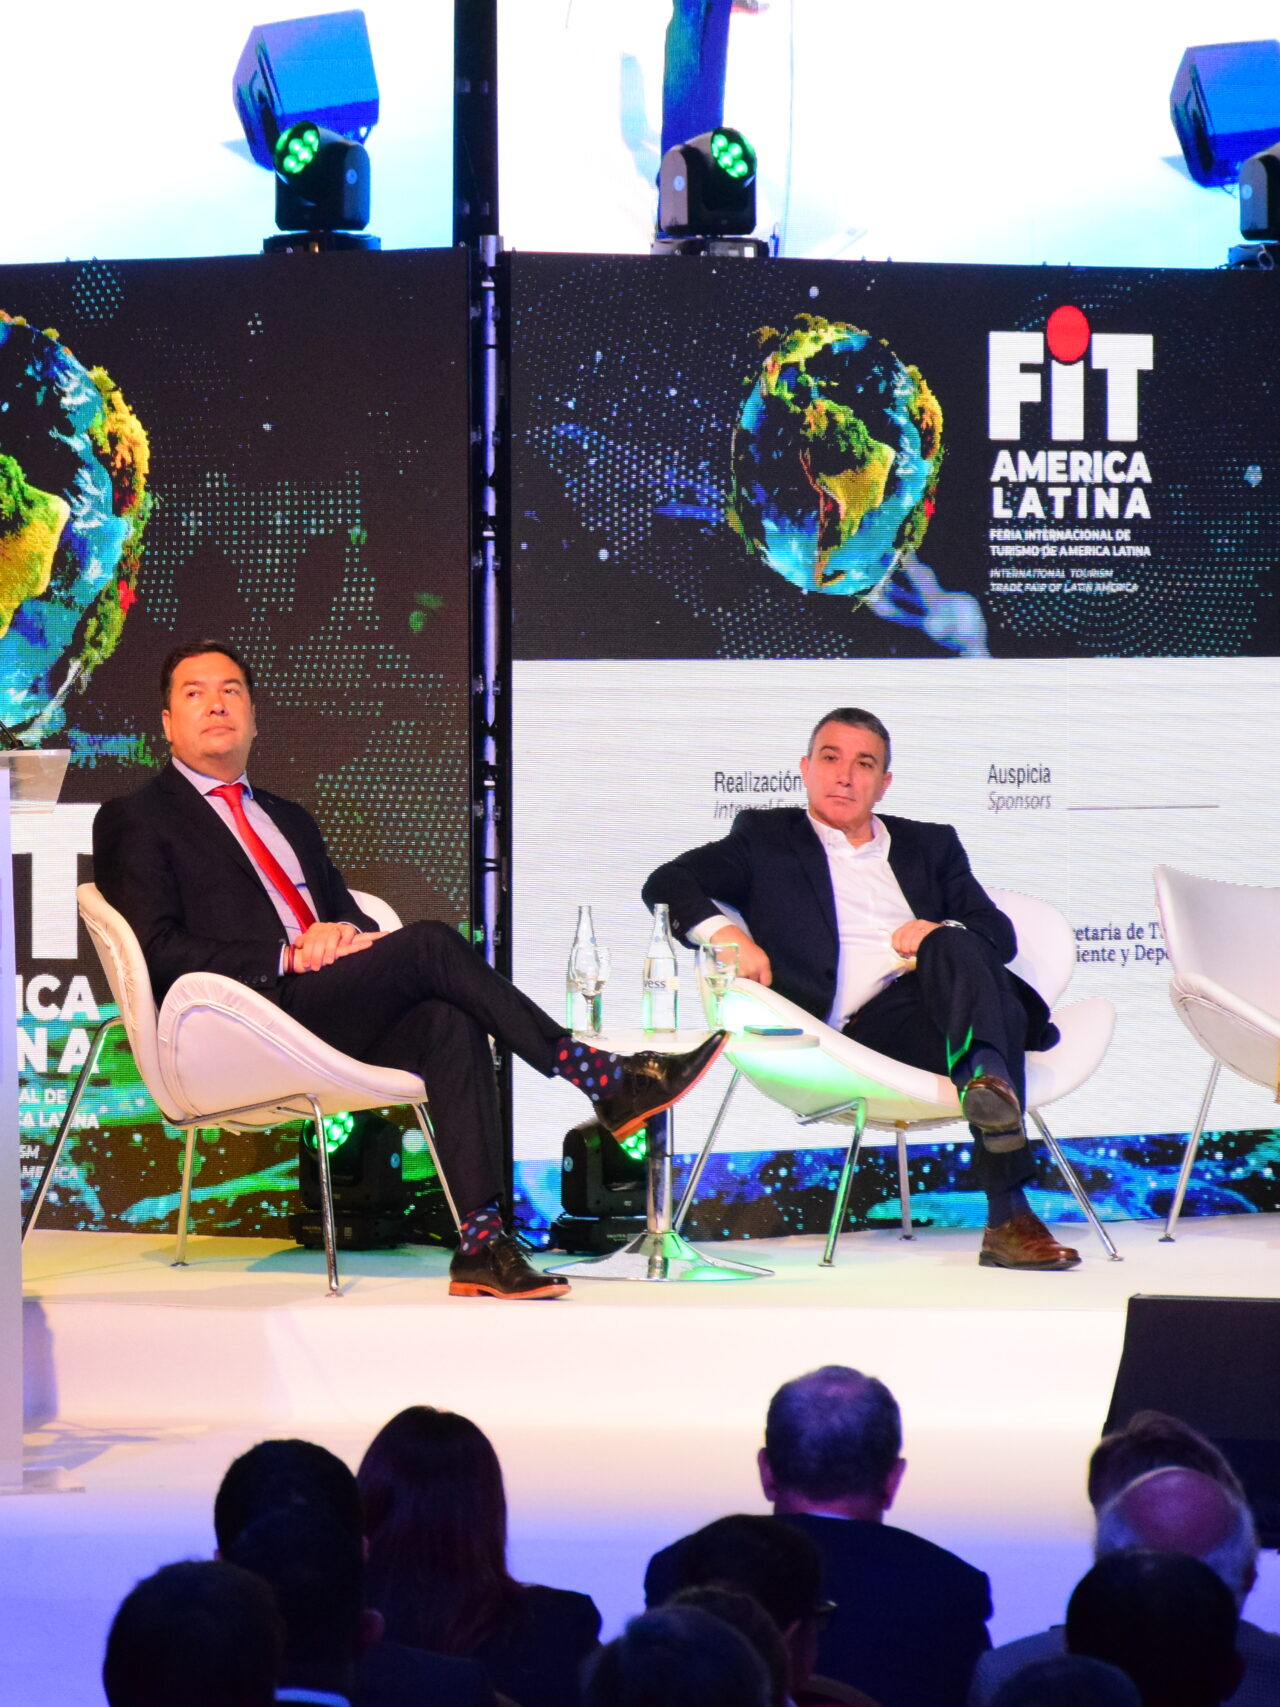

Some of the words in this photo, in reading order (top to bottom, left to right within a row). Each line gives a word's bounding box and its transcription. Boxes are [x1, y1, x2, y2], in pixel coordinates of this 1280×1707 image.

[990, 451, 1152, 483] AMERICA
[992, 486, 1151, 519] LATINA
[989, 529, 1022, 541] FERIA
[1024, 529, 1113, 541] INTERNACIONAL
[1115, 529, 1131, 541] DE
[989, 545, 1039, 557] TURISMO
[1042, 545, 1057, 557] DE
[1059, 546, 1110, 557] AMERICA
[1112, 546, 1151, 557] LATINA
[714, 770, 802, 793] Realización
[987, 763, 1052, 789] Auspicia
[987, 791, 1052, 814] Sponsors
[1126, 921, 1144, 940] de
[1120, 948, 1130, 967] y
[44, 1088, 67, 1104] DE
